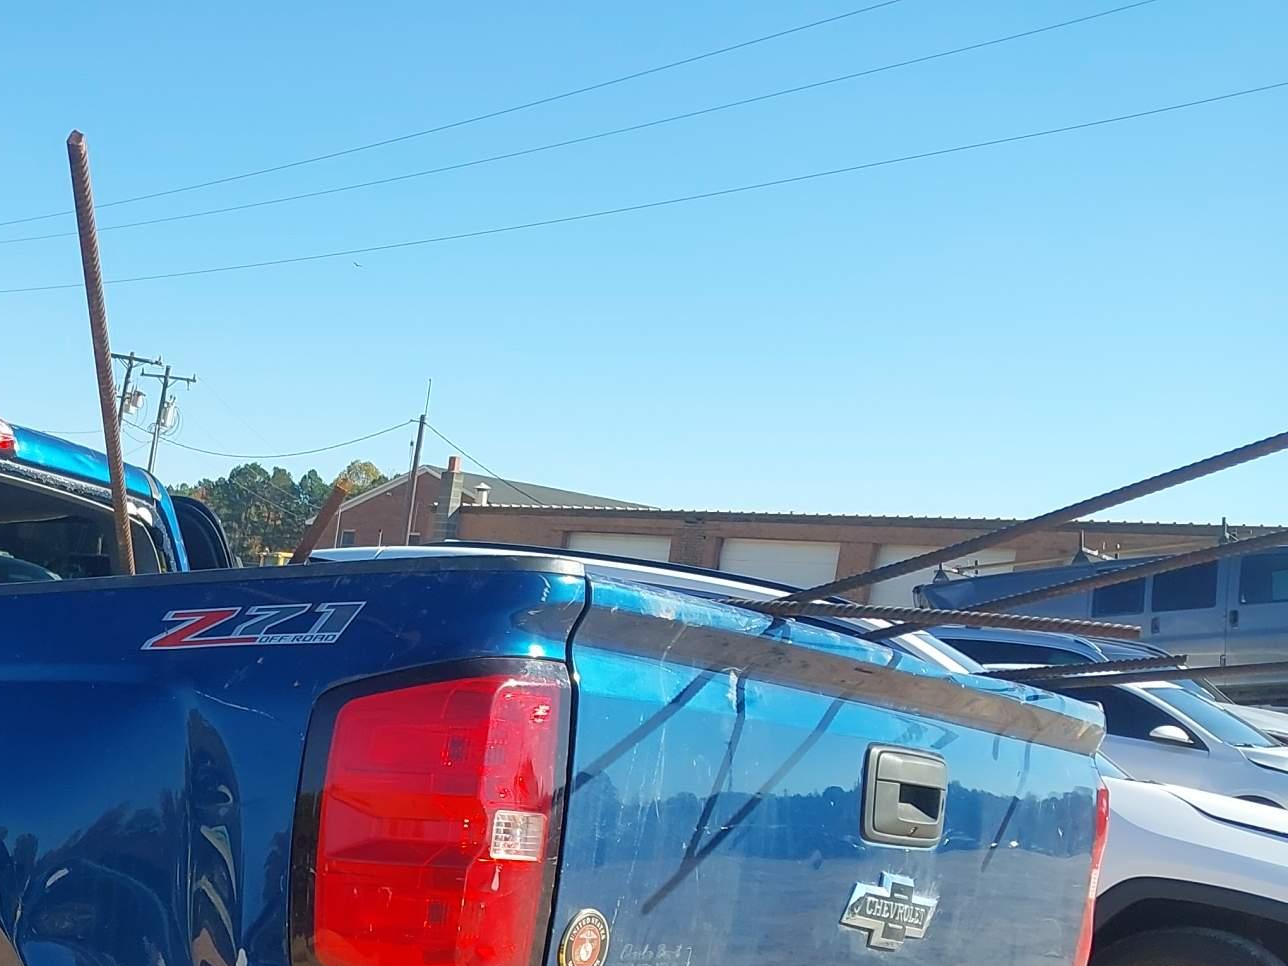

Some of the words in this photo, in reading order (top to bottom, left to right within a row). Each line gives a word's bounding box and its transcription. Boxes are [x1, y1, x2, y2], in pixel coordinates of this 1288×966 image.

[140, 601, 368, 651] Z71
[865, 896, 926, 925] CHEVROLET
[569, 917, 591, 941] UNITED
